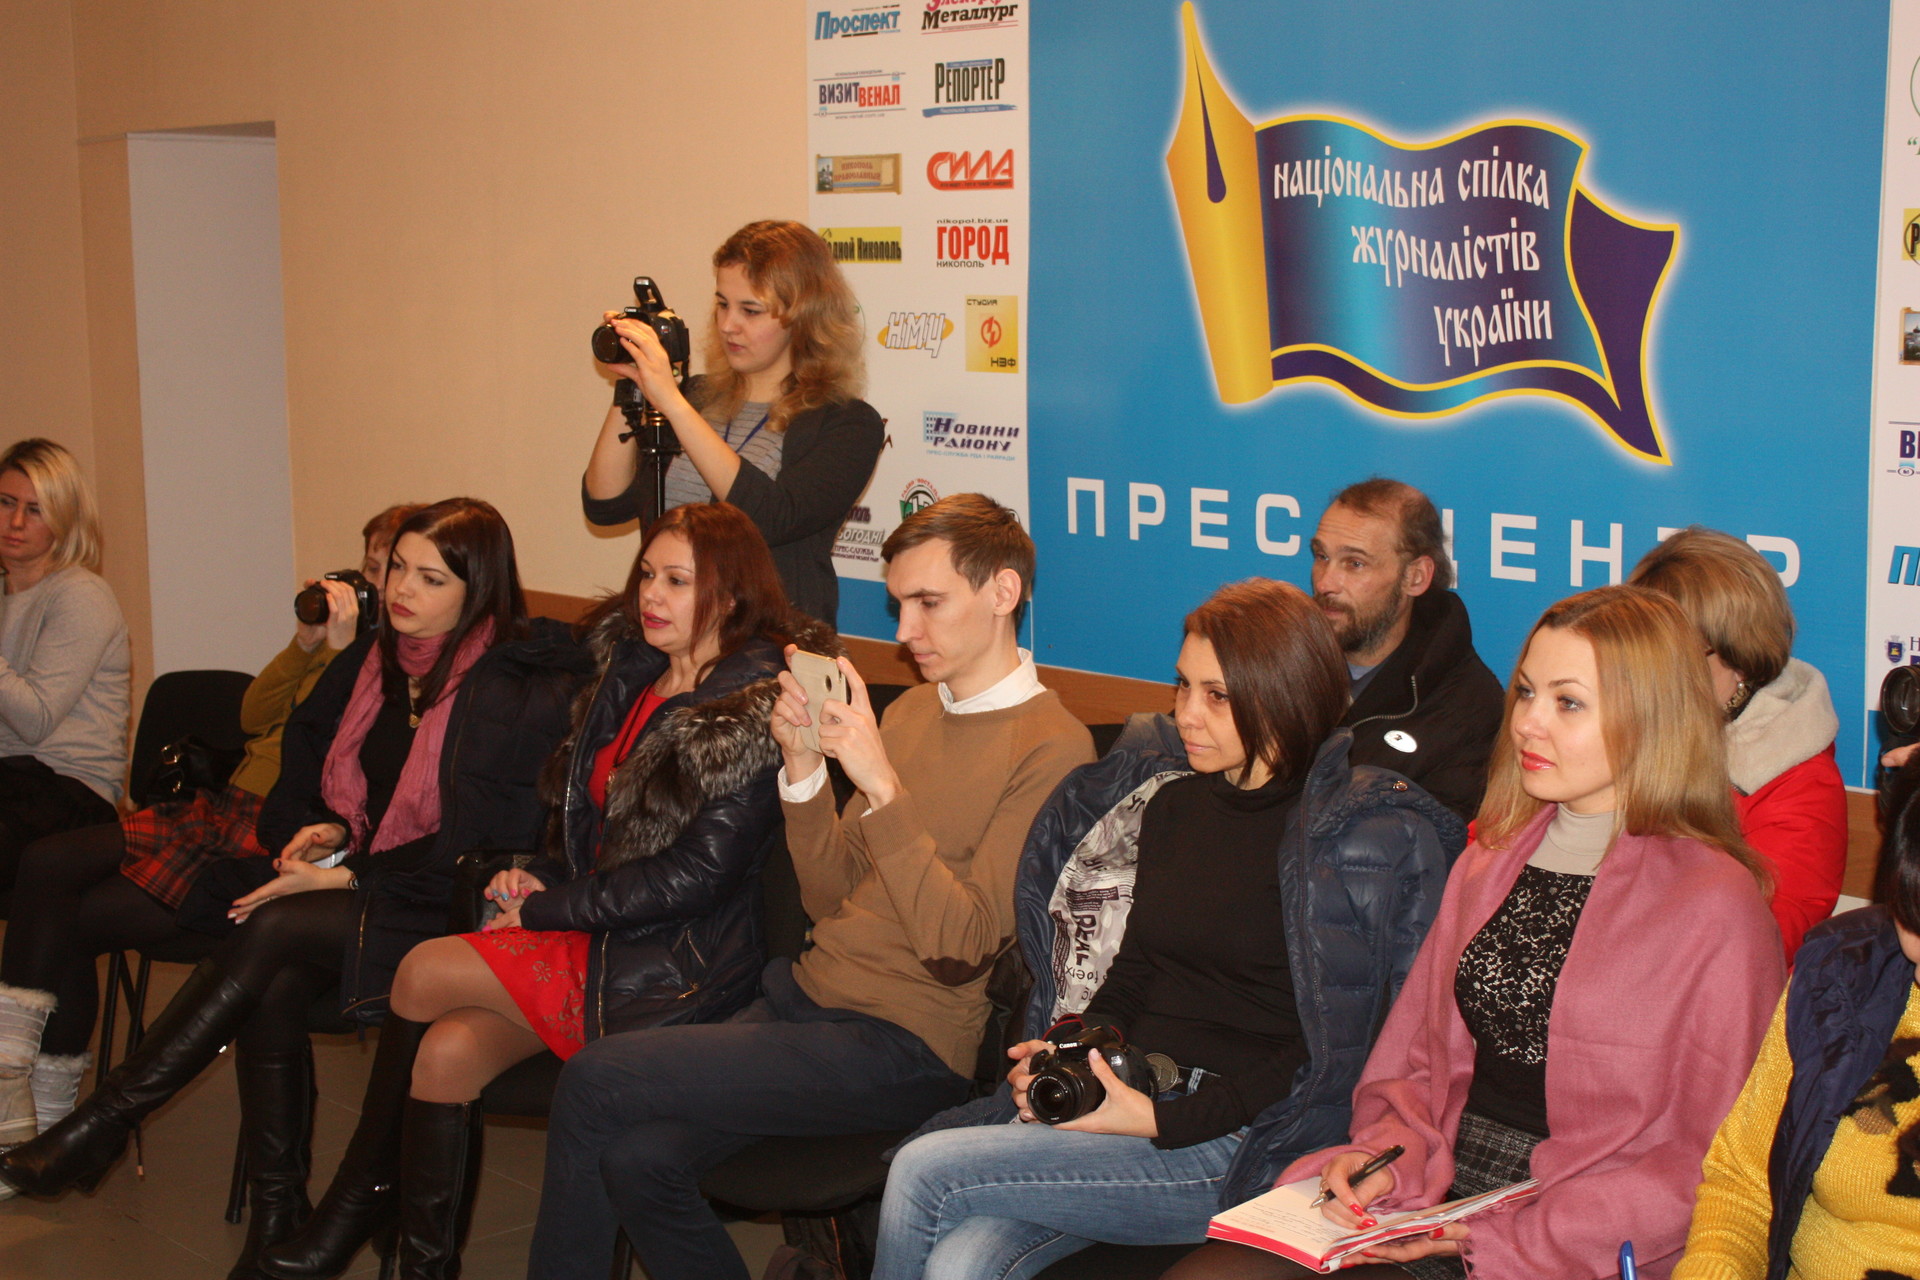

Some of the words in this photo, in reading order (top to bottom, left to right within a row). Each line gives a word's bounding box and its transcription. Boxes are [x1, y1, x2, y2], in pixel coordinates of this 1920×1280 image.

[814, 11, 901, 40] Проспект
[921, 4, 1018, 30] Металлург
[935, 58, 1005, 103] РЕПОРТЕР
[937, 225, 1009, 266] ГОРОД
[936, 260, 985, 268] НИКОПОЛЬ
[1067, 477, 1301, 557] ПРЕС
[1441, 508, 1801, 590] ЕНР
